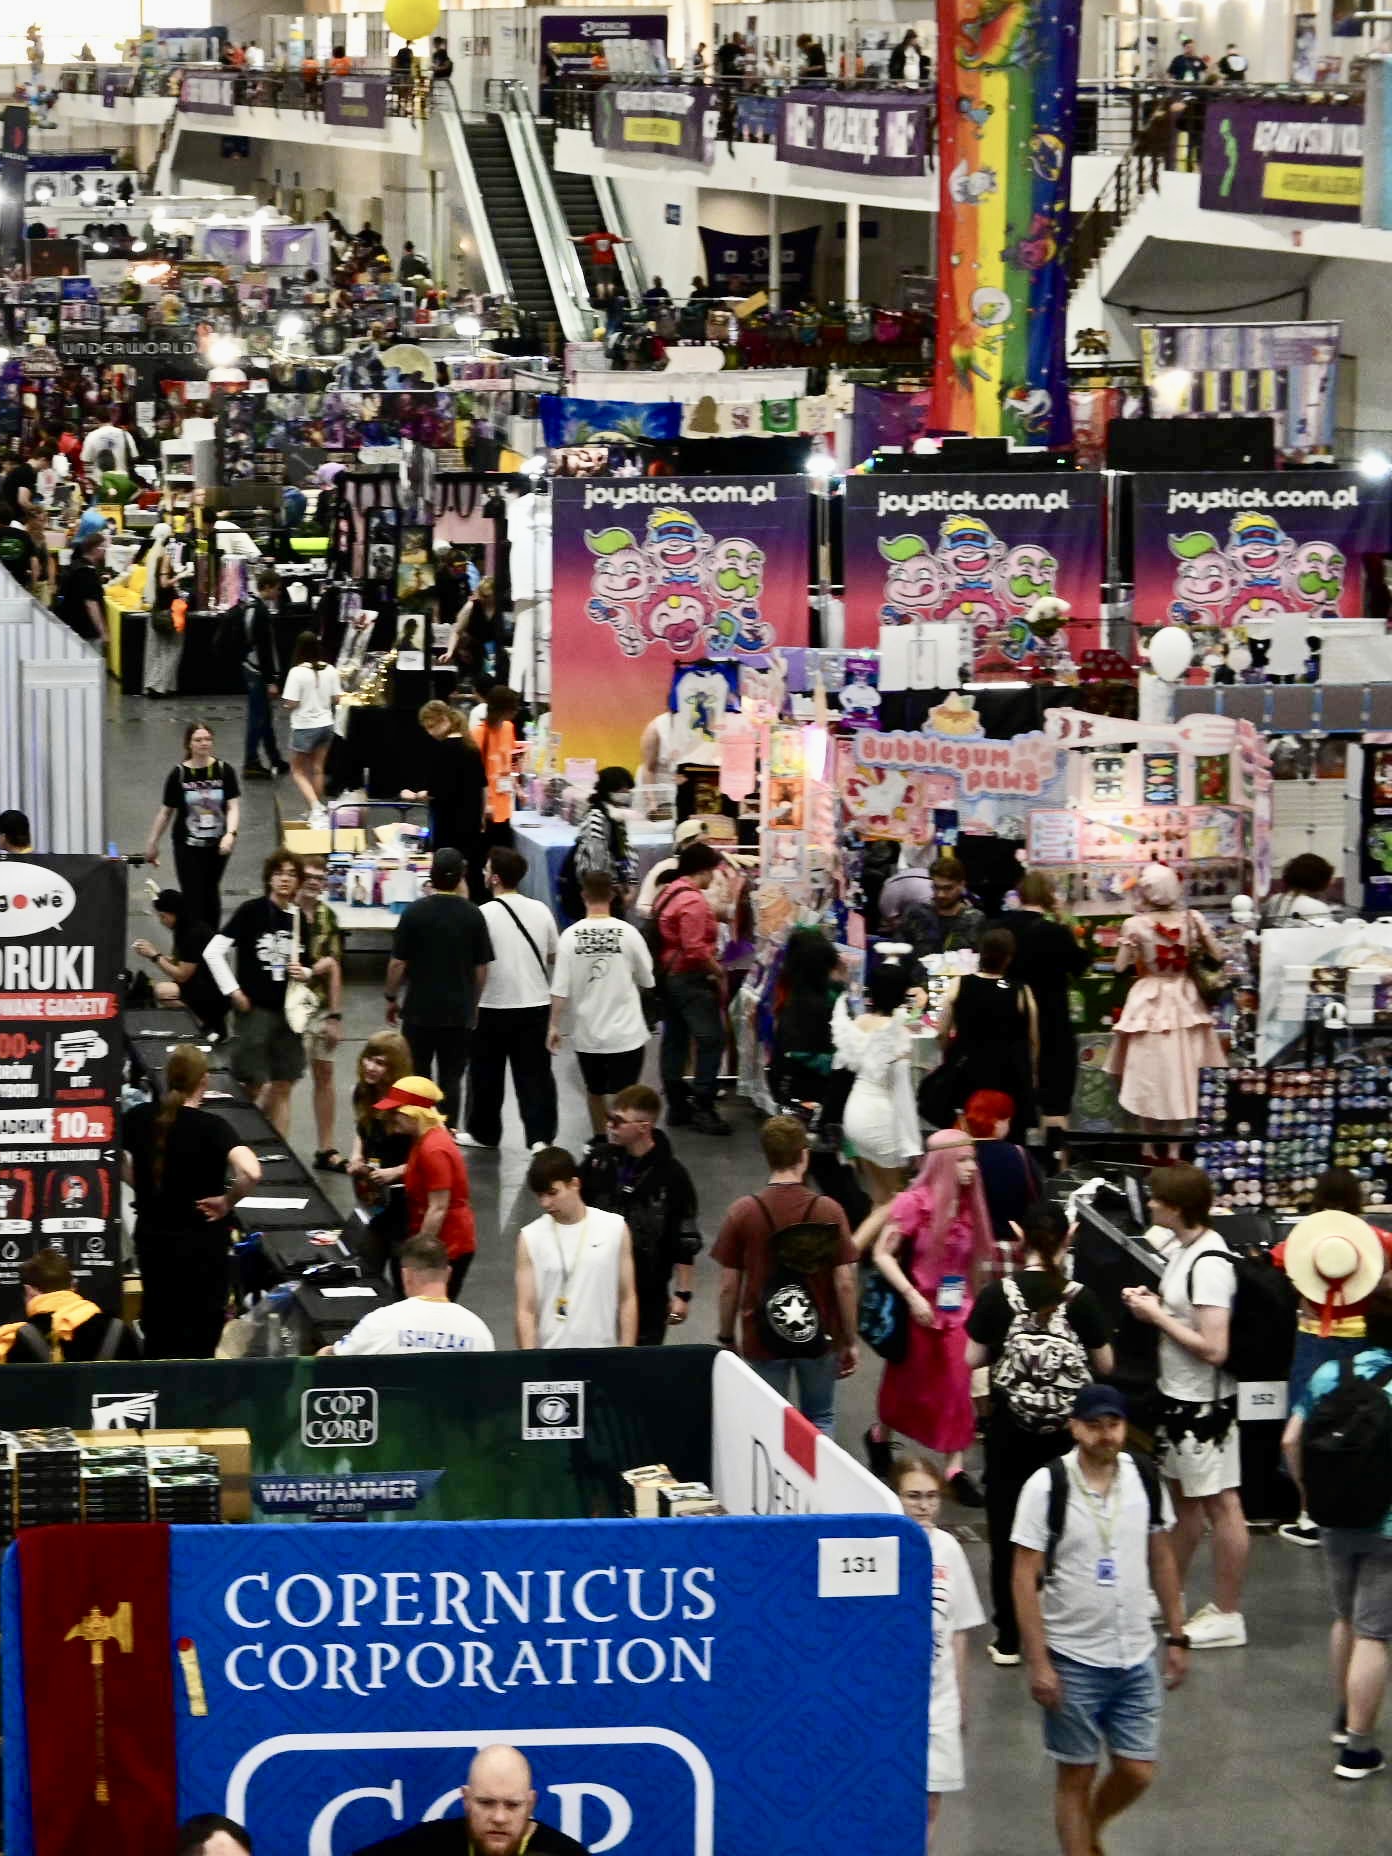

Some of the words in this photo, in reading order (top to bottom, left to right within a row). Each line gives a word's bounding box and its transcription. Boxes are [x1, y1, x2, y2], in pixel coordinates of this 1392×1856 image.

[583, 482, 777, 510] joystick.com.pl
[877, 489, 1070, 517] joystick.com.pl
[1167, 486, 1360, 515] joystick.com.pl
[574, 928, 624, 937] SASUKE
[578, 937, 620, 945] ITACHI
[574, 946, 622, 954] UCHIHA
[314, 1395, 366, 1416] COP
[307, 1420, 373, 1442] CORP
[260, 1479, 417, 1503] WARHAMMER
[840, 1556, 878, 1574] 131
[223, 1566, 716, 1633] COPERNICUS
[223, 1636, 715, 1697] CORPORATION
[309, 1778, 634, 1856] CP
